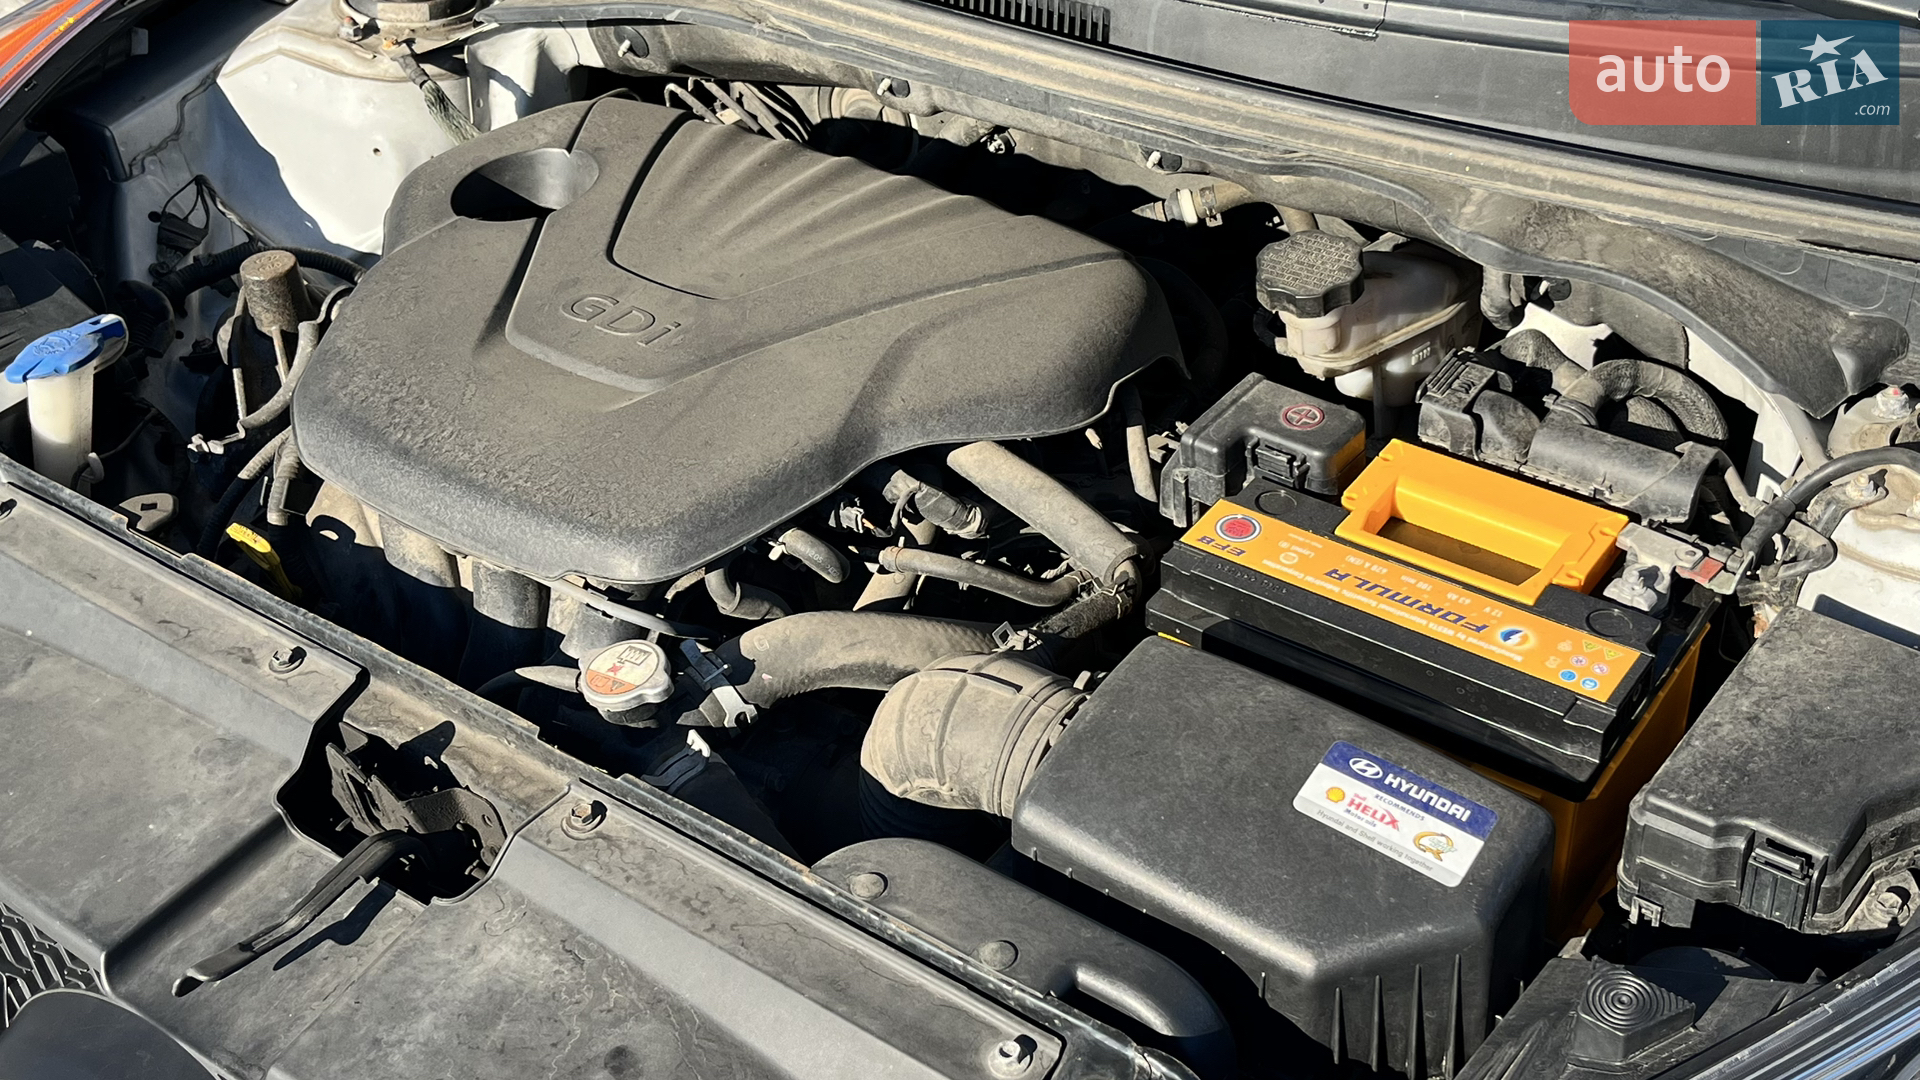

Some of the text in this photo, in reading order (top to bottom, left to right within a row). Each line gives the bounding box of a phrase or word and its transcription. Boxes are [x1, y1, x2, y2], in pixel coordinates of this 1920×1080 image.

[561, 293, 681, 347] GDi
[1197, 535, 1246, 556] EFB
[1324, 568, 1490, 633] FORMULA
[1347, 797, 1400, 832] HELIX
[1374, 793, 1425, 821] RECOMMENDS
[1384, 773, 1472, 822] HYUNDAI
[1316, 809, 1434, 873] Hyundai and Shell working together
